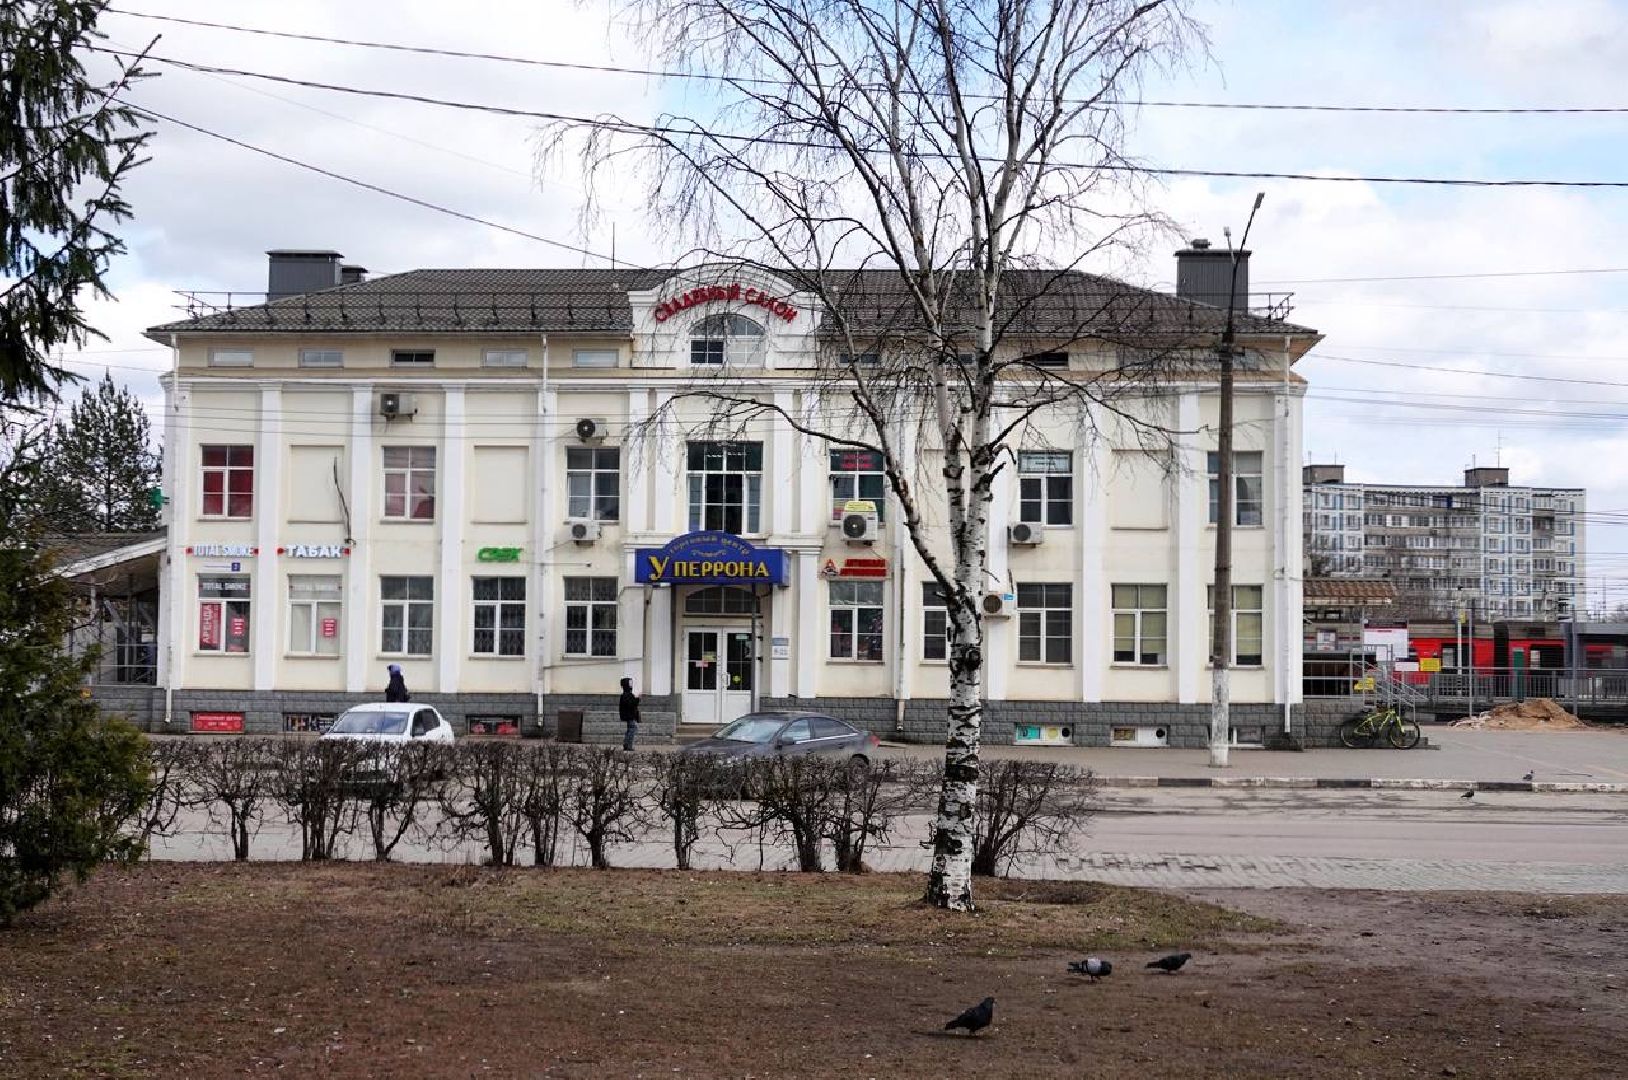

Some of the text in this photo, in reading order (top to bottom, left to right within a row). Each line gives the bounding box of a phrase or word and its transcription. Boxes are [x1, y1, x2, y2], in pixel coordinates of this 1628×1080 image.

[287, 545, 341, 558] ТАБАК
[649, 556, 770, 581] У ПЕРРОНА
